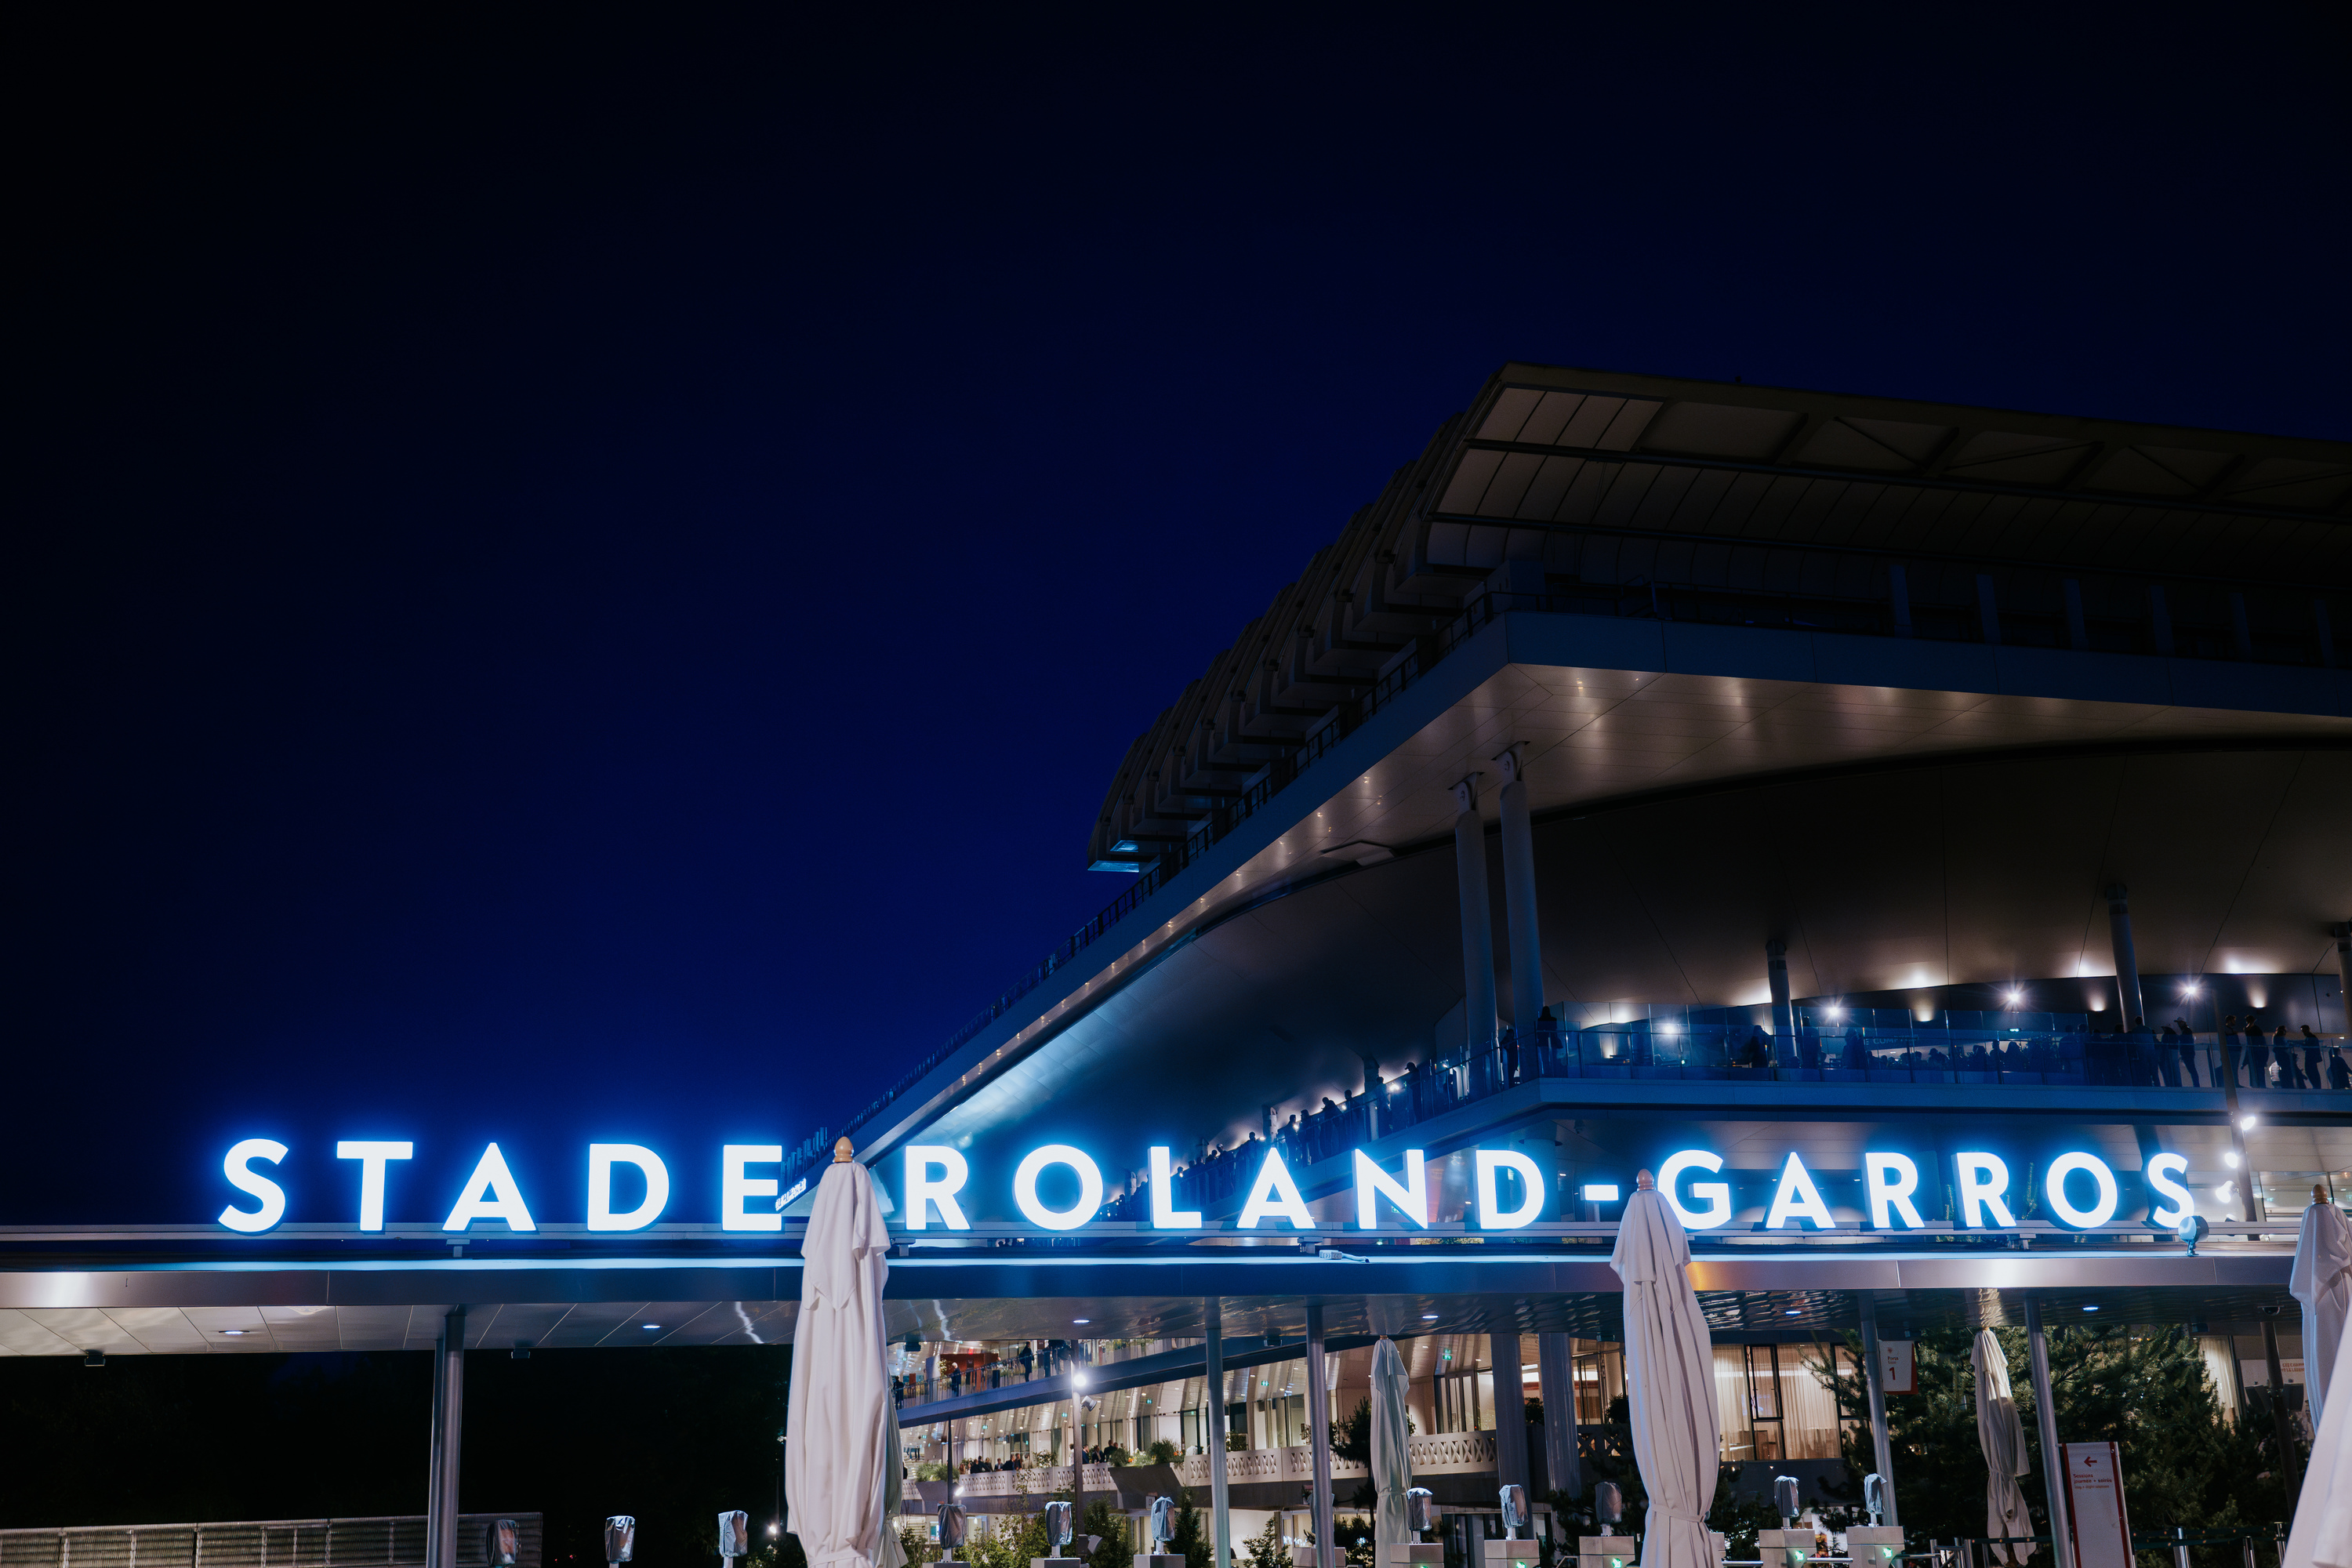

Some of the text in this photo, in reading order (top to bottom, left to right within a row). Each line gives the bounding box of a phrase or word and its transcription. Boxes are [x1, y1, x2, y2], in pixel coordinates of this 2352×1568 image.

[218, 1138, 2195, 1233] STADE ROLAND-GARROS
[1889, 1367, 1896, 1381] 1
